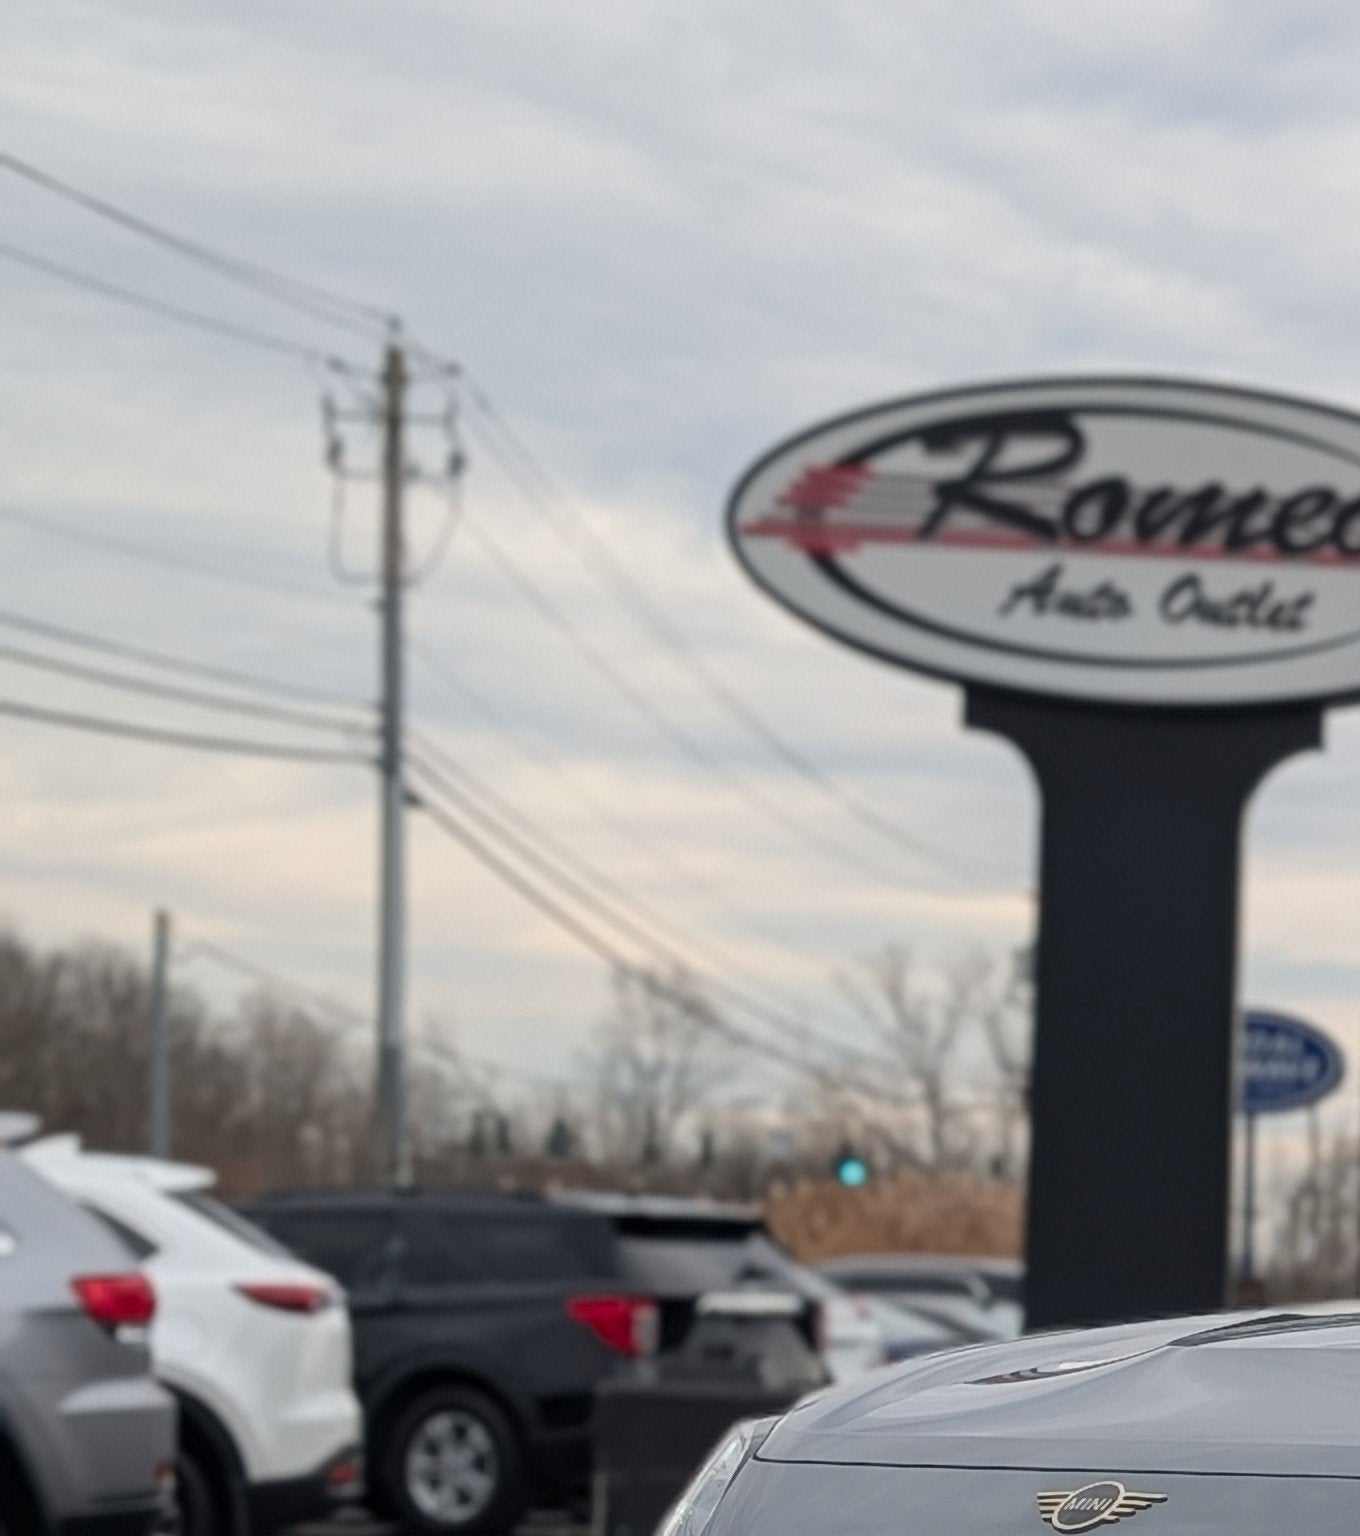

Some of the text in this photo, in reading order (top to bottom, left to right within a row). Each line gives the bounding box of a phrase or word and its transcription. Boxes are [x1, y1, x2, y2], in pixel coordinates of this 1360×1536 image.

[998, 564, 1314, 633] Auto Outlet
[1064, 1497, 1113, 1511] MINI
